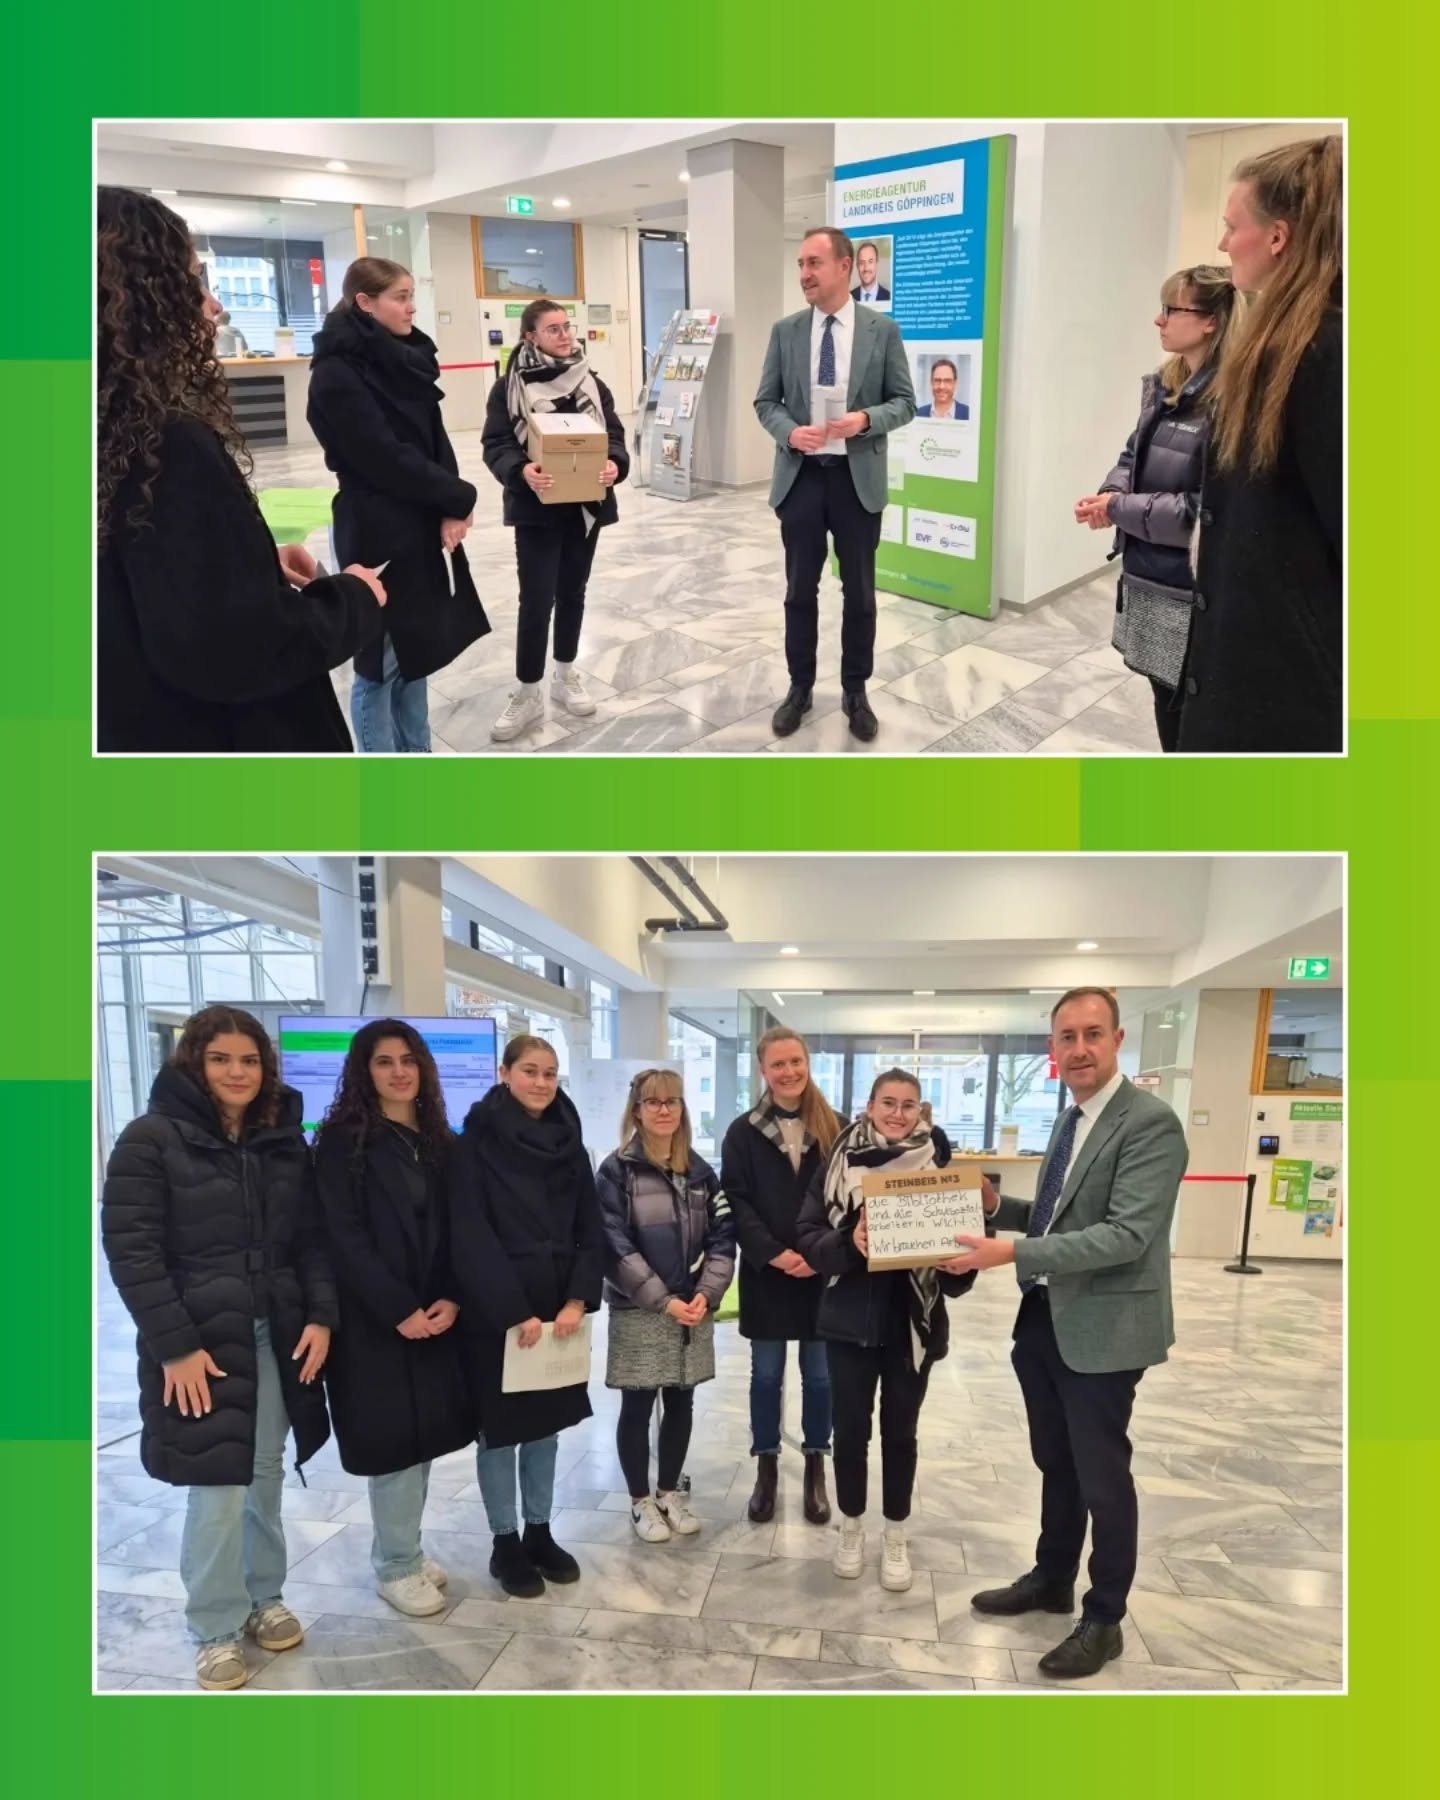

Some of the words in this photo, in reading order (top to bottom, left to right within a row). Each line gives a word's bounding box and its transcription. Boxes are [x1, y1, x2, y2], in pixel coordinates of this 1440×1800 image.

[843, 179, 927, 203] ENERGIEAGENTUR
[843, 200, 894, 218] LANDKREIS
[896, 191, 955, 211] GÖPPINGEN
[915, 532, 932, 543] EVF
[884, 1176, 938, 1189] STEINBEIS
[868, 1197, 889, 1209] die
[868, 1209, 891, 1220] und
[894, 1208, 913, 1219] die
